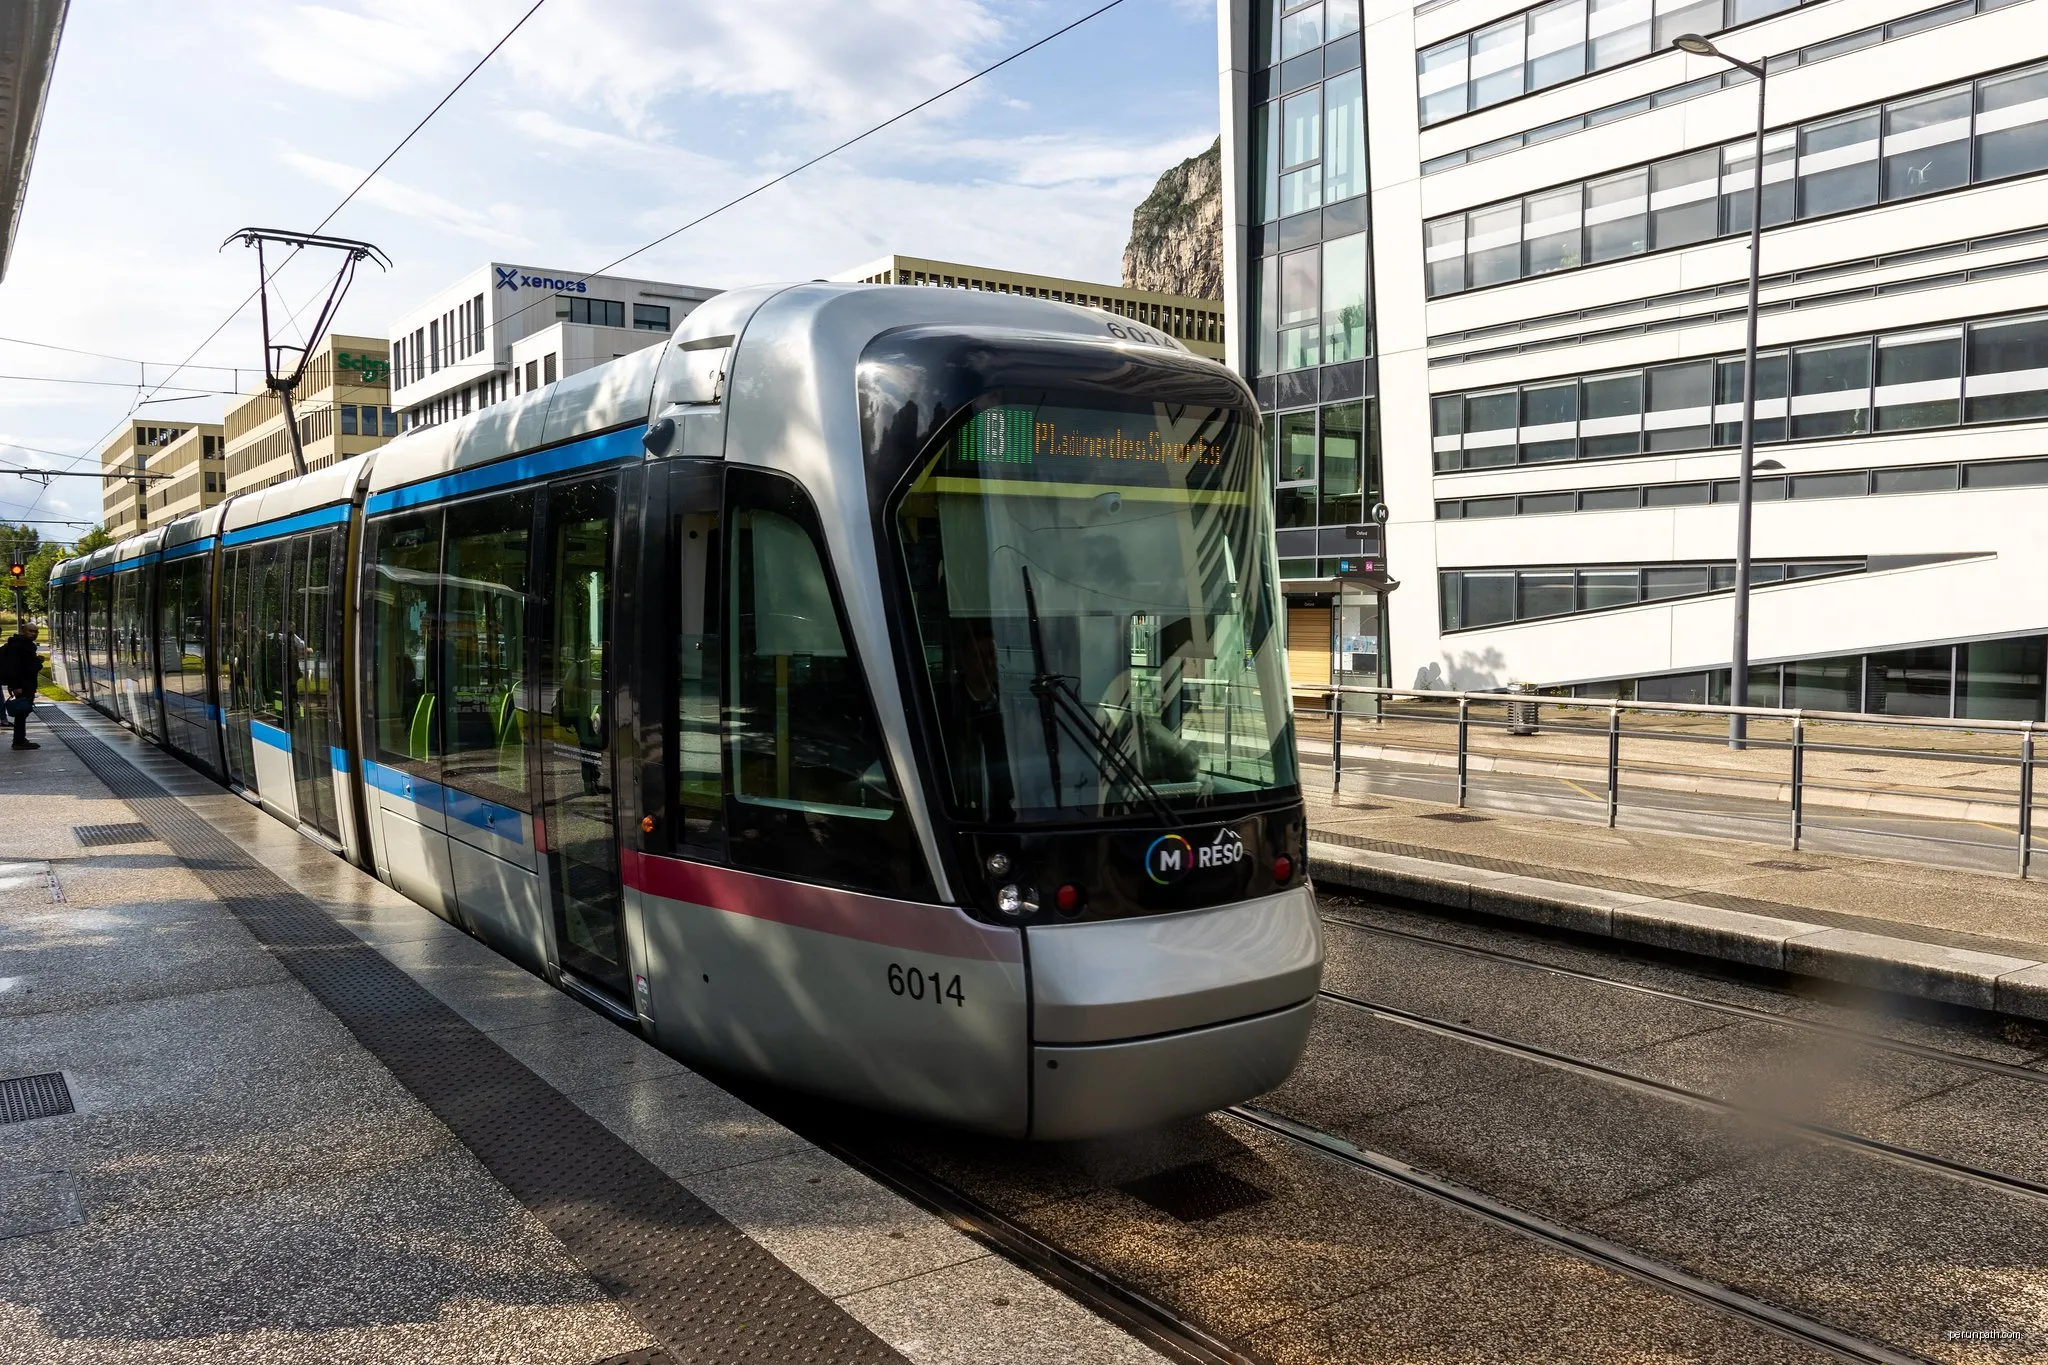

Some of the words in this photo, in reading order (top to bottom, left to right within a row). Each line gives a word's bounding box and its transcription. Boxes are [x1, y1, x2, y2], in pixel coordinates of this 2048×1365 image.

[520, 274, 587, 293] xenocs
[1106, 322, 1178, 350] 6014
[1109, 428, 1147, 460] des
[1148, 431, 1220, 465] Sports
[1379, 510, 1386, 518] M
[1160, 850, 1181, 871] M
[887, 963, 966, 1008] 6014
